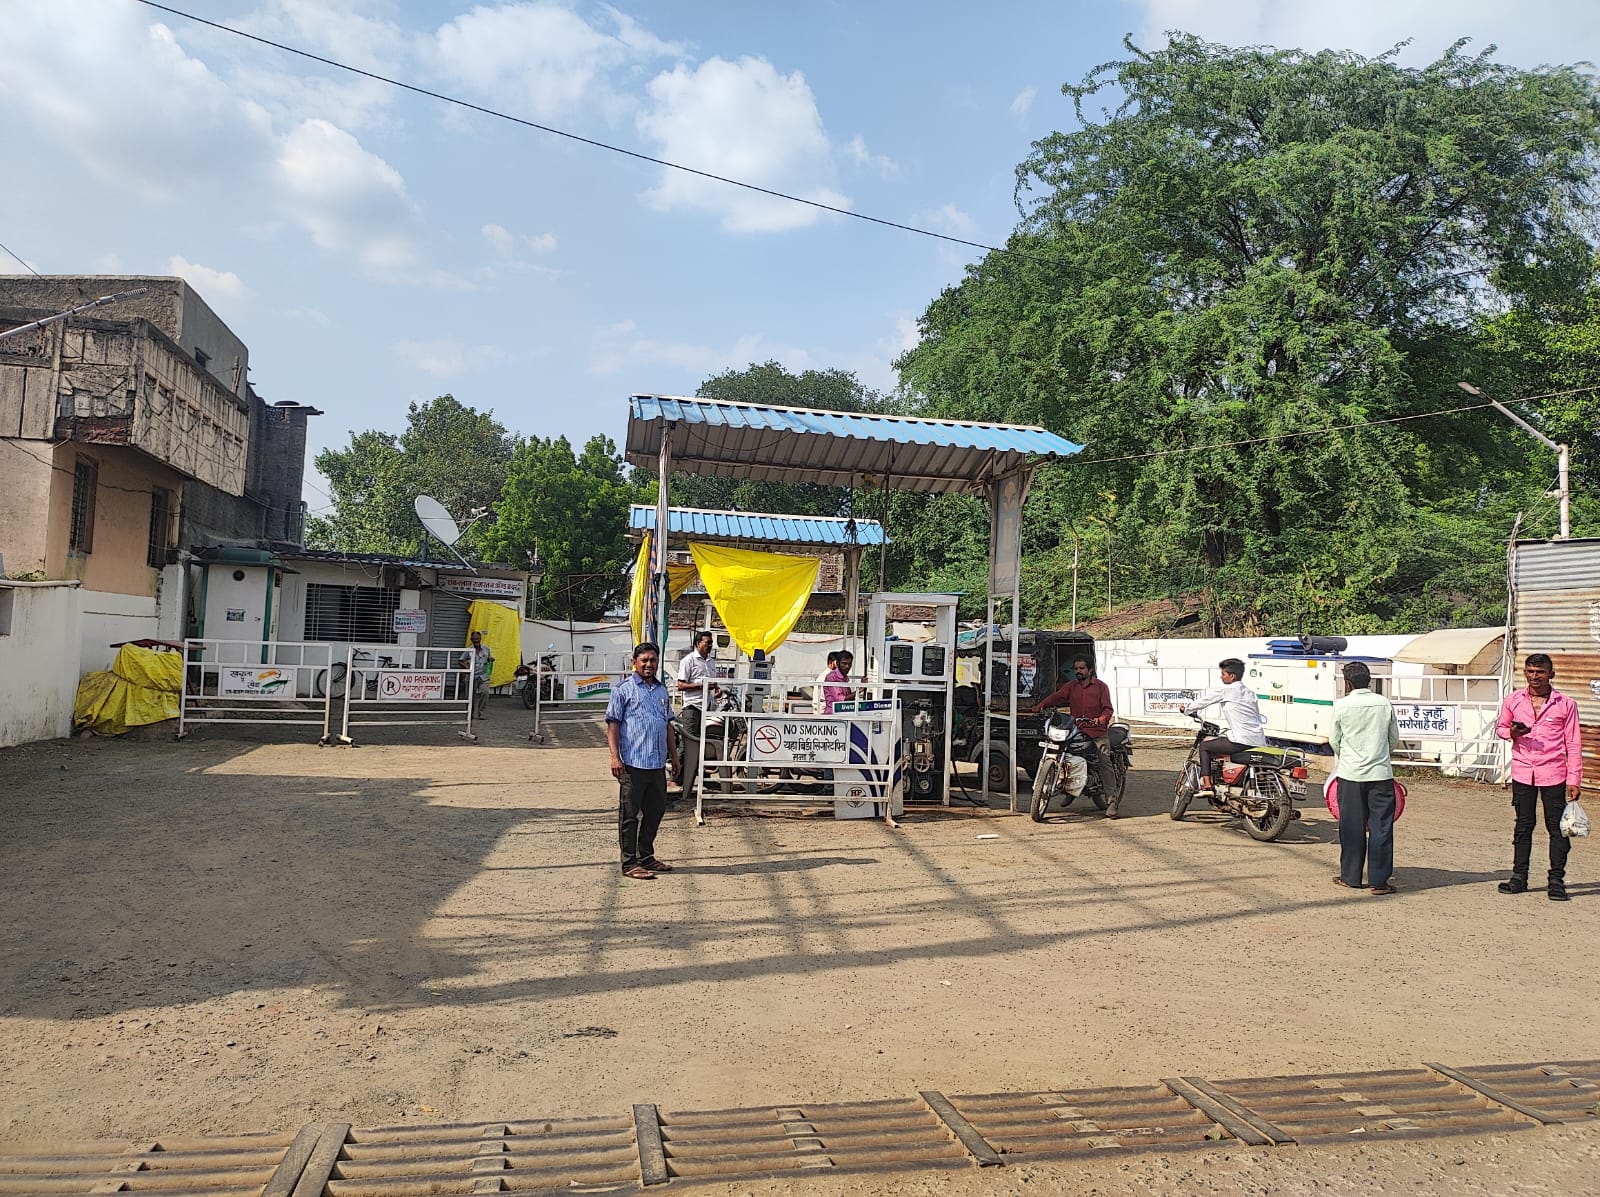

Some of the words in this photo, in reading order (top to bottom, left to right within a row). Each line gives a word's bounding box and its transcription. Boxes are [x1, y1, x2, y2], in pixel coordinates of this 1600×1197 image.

[415, 676, 440, 684] PARKING
[1413, 705, 1420, 718] है
[1398, 717, 1423, 729] भरोसा
[783, 724, 797, 734] NO
[799, 725, 838, 736] SMOKING
